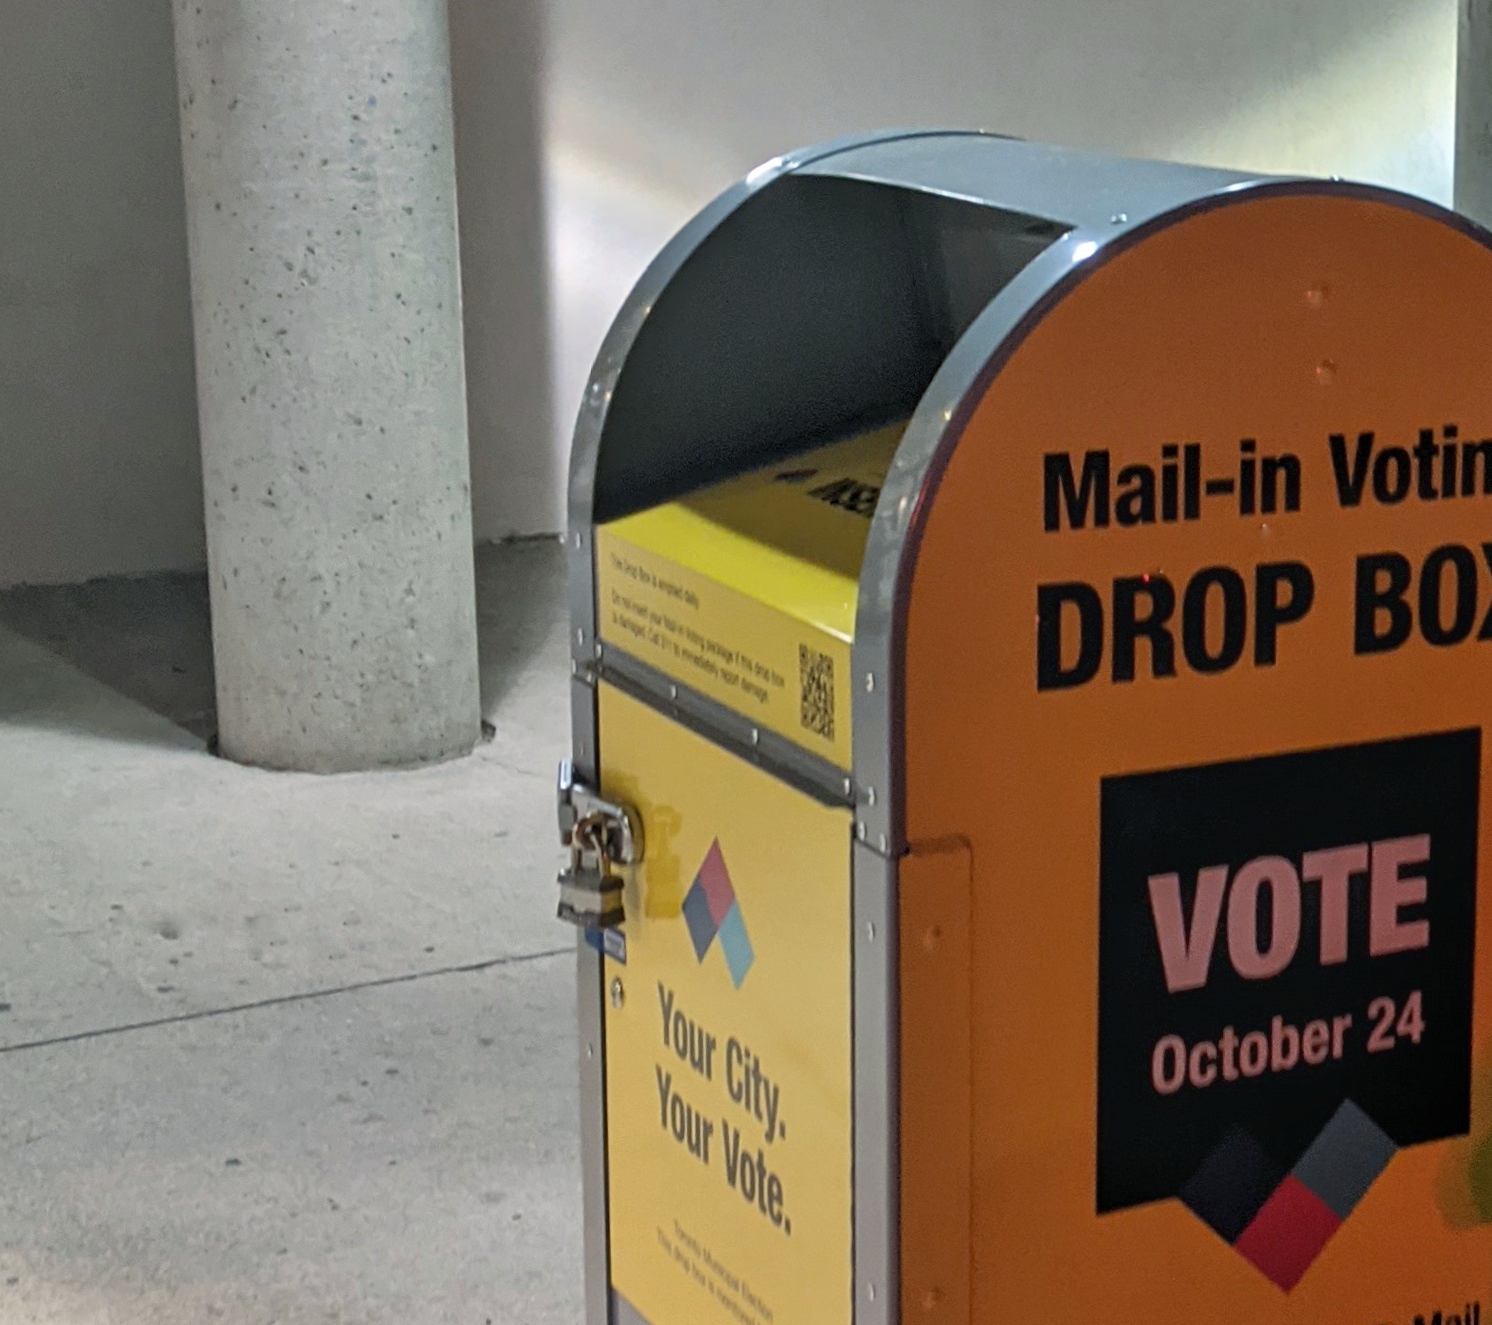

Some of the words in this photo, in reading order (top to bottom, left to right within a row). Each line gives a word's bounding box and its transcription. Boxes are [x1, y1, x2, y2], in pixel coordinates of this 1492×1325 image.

[1043, 438, 1301, 533] Mail-in
[1036, 560, 1315, 693] DROP
[1147, 833, 1431, 995] VOTE
[657, 979, 717, 1082] Your
[725, 1035, 787, 1145] City.
[1151, 1013, 1353, 1096] October
[1366, 990, 1426, 1052] 24
[655, 1062, 714, 1166] Your
[721, 1118, 792, 1237] Vote.
